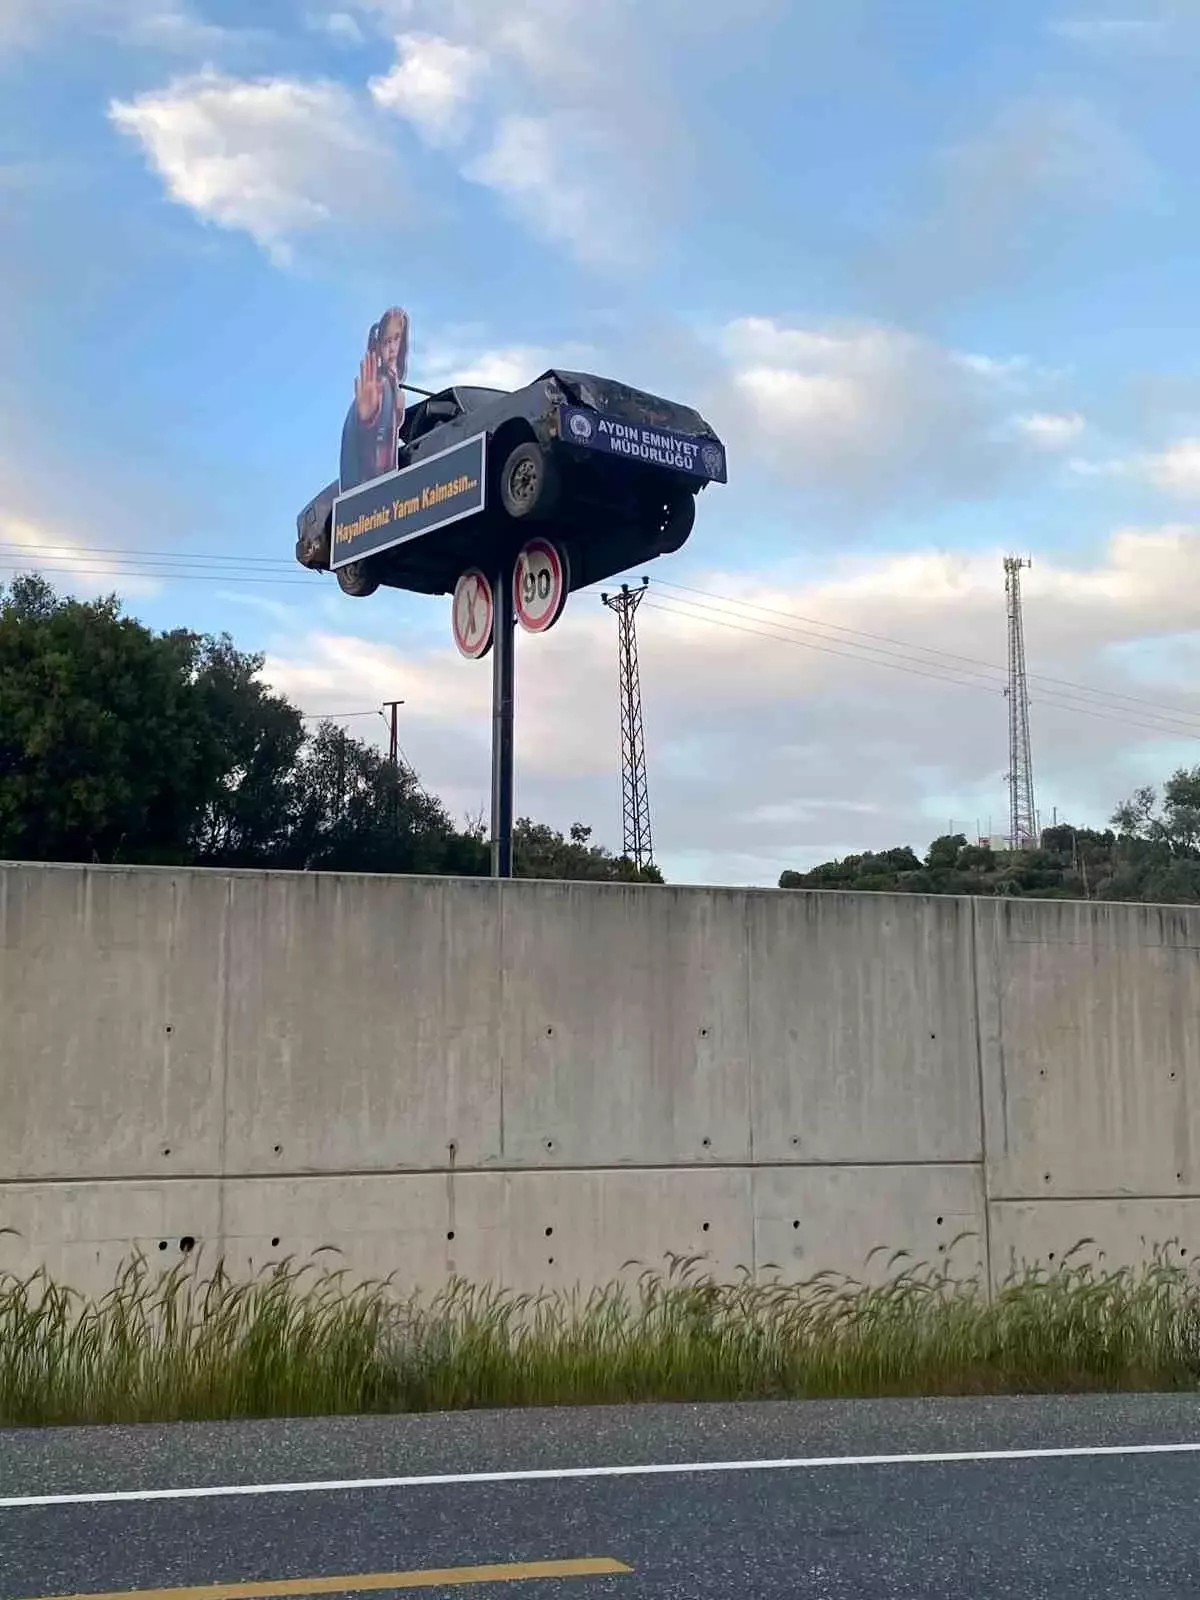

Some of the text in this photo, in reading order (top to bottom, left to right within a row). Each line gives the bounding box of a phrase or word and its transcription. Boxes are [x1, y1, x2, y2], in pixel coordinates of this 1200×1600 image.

[599, 420, 638, 440] AYDIN
[642, 431, 700, 457] EMNİYET
[611, 437, 693, 470] MÜDÜRLÜĞÜ
[336, 506, 390, 544] Hayalleriniz
[392, 496, 419, 520] Yarım
[524, 568, 551, 603] 90
